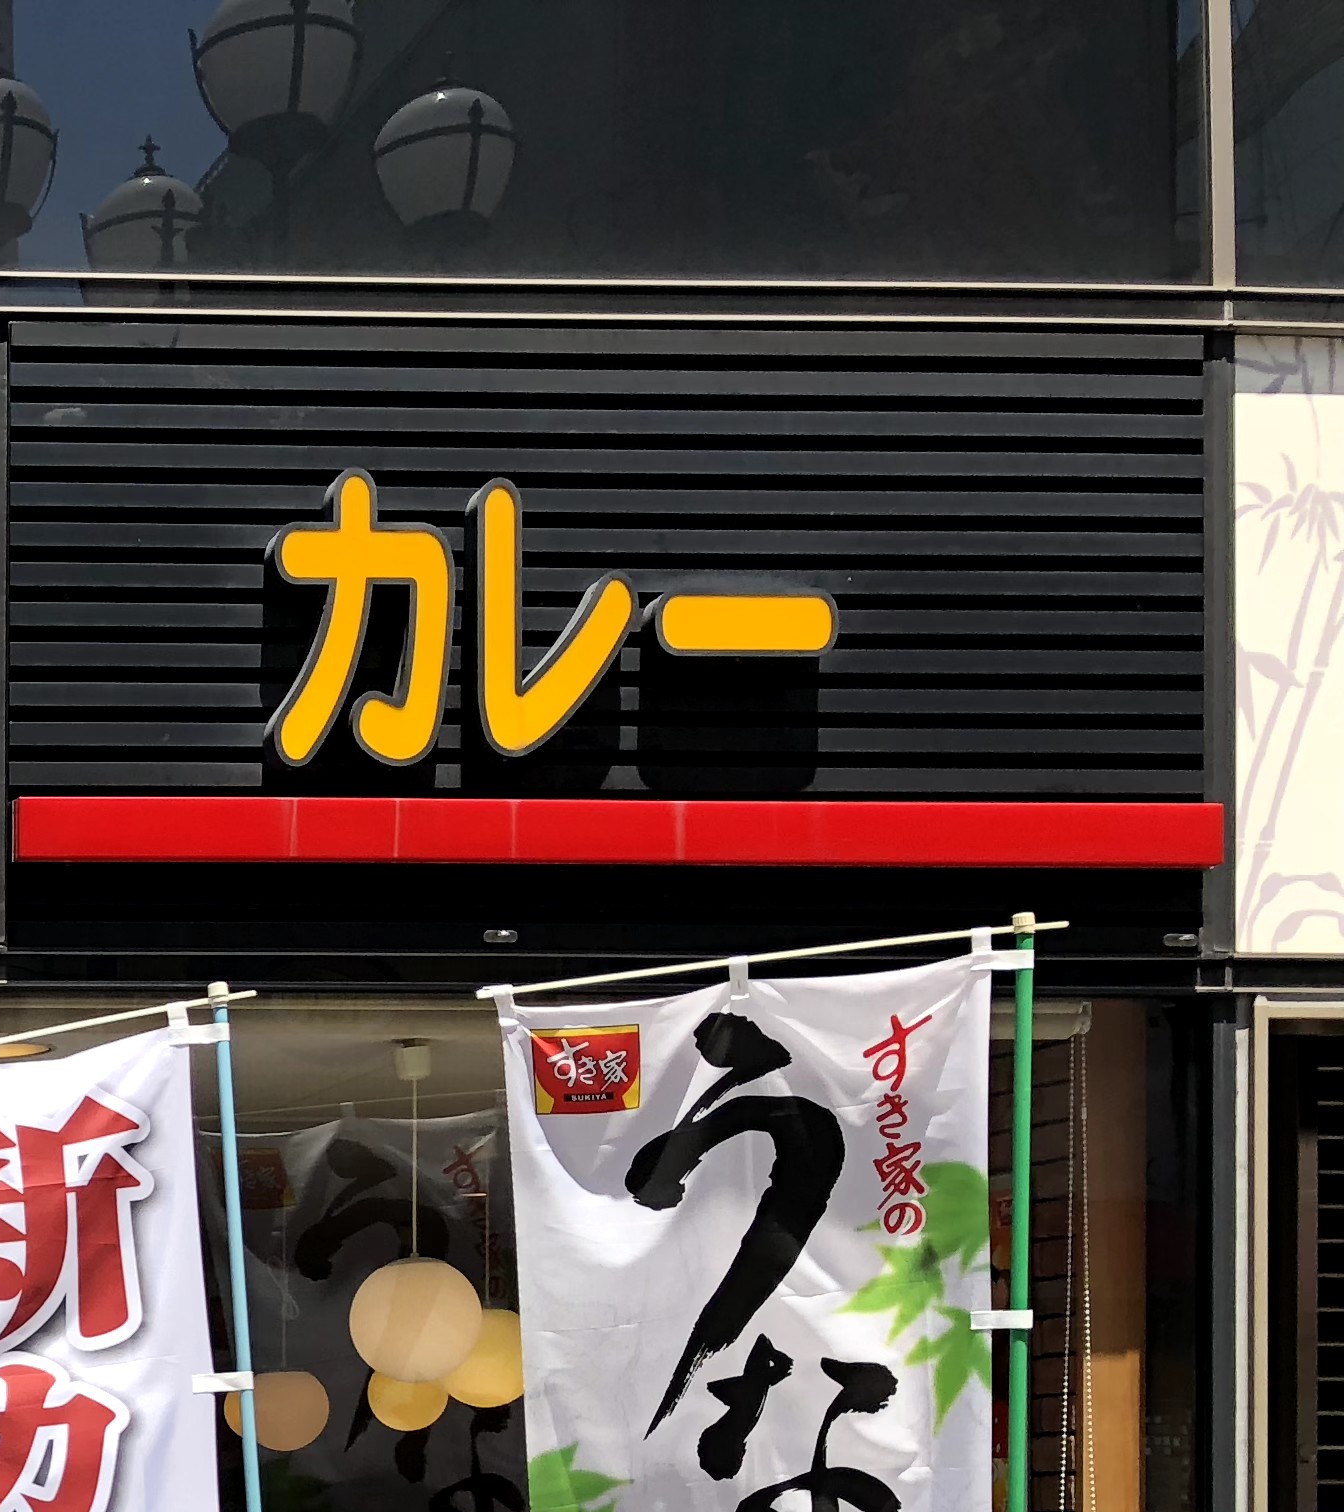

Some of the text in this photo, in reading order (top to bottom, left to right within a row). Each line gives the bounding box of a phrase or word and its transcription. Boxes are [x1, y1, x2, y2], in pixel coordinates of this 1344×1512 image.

[276, 472, 836, 765] カレー
[546, 1038, 630, 1091] すき家
[569, 1092, 609, 1102] SUKIYA
[863, 1014, 933, 1237] すき家の
